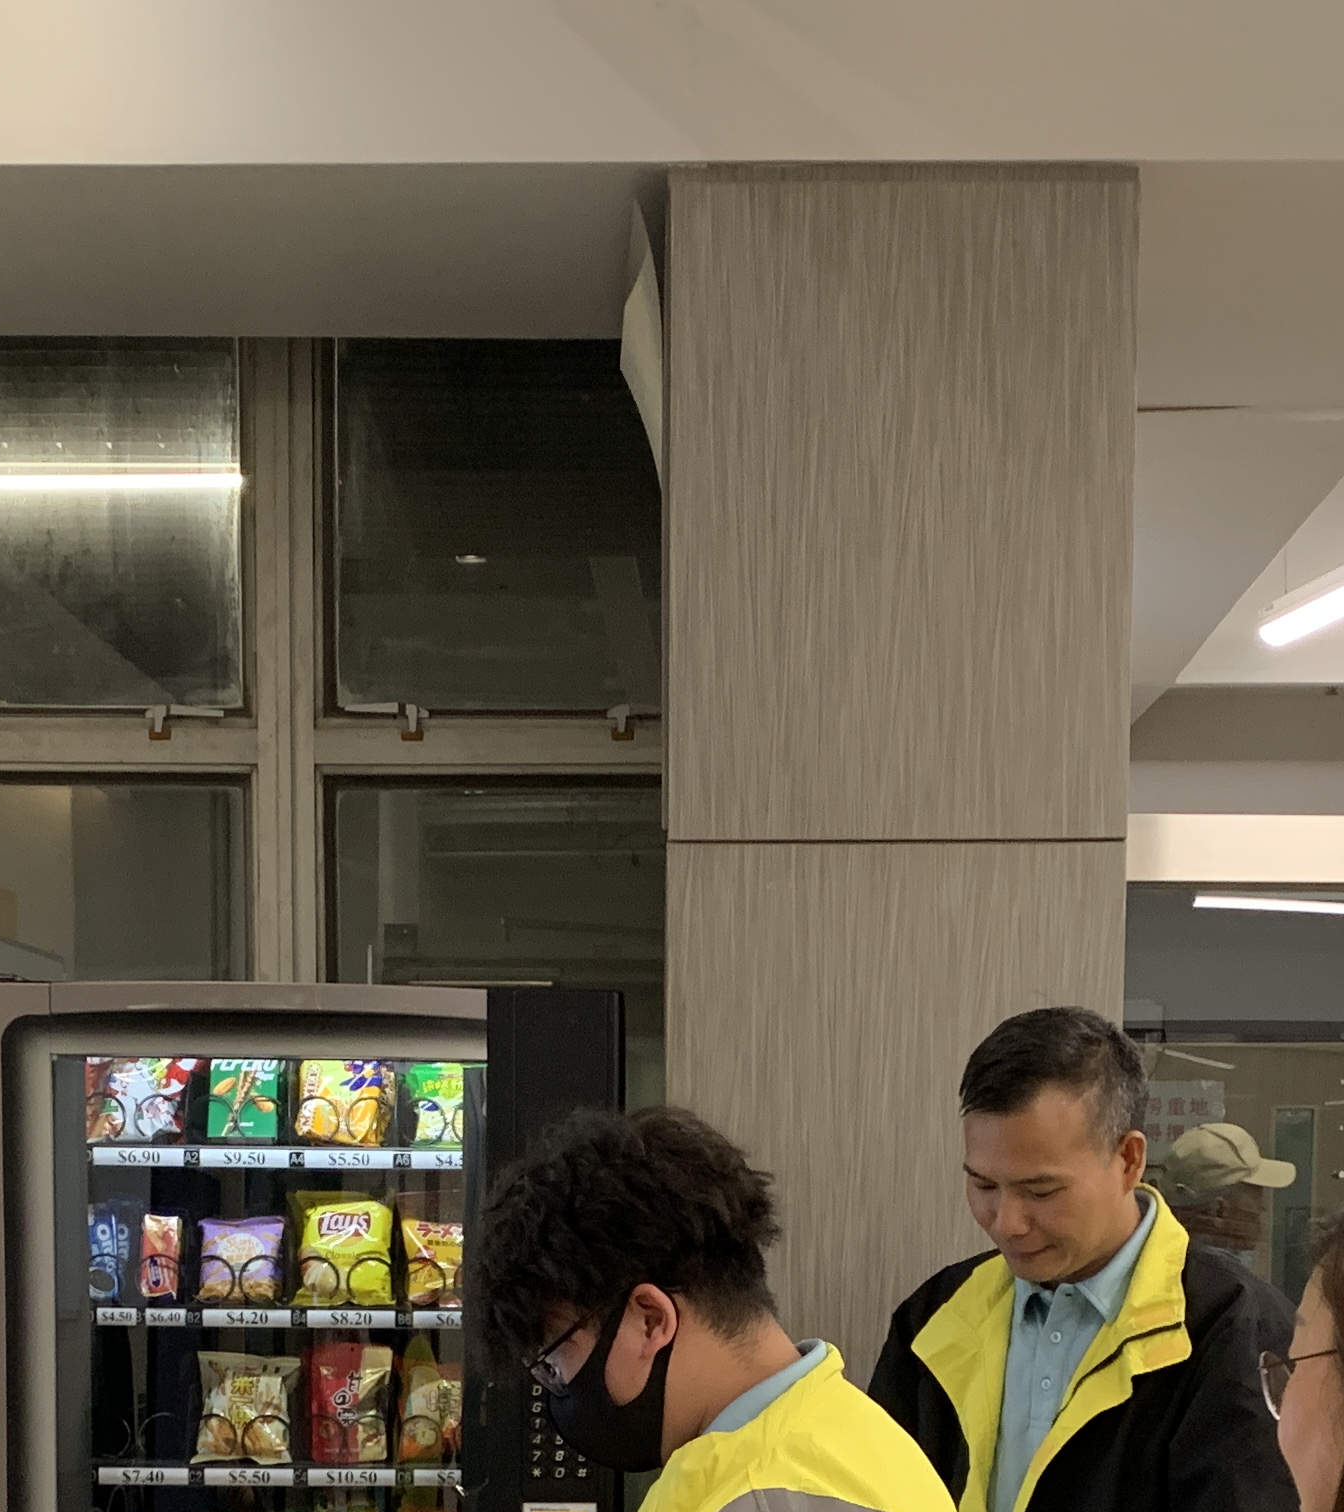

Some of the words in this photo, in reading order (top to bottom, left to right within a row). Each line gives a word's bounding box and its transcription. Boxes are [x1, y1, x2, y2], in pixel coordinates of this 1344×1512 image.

[118, 1151, 161, 1164] $6.90
[184, 1152, 200, 1164] A2
[224, 1152, 266, 1165] $9.50
[290, 1152, 305, 1166] A4
[328, 1152, 371, 1166] $5.50
[395, 1154, 410, 1166] A6
[101, 1310, 132, 1322] $4.50
[150, 1311, 181, 1323] $6.40
[187, 1311, 201, 1324] B2
[226, 1311, 269, 1325] $4.20
[292, 1311, 307, 1324] B4
[330, 1312, 372, 1326] $8.20
[436, 1313, 462, 1327] $6.
[532, 1385, 543, 1396] D
[532, 1402, 543, 1413] G
[532, 1450, 542, 1461] 7
[555, 1450, 565, 1461] 8
[121, 1470, 165, 1484] $7.40
[228, 1471, 270, 1484] $5.50
[326, 1470, 378, 1485] $10.50
[555, 1467, 565, 1478] 0
